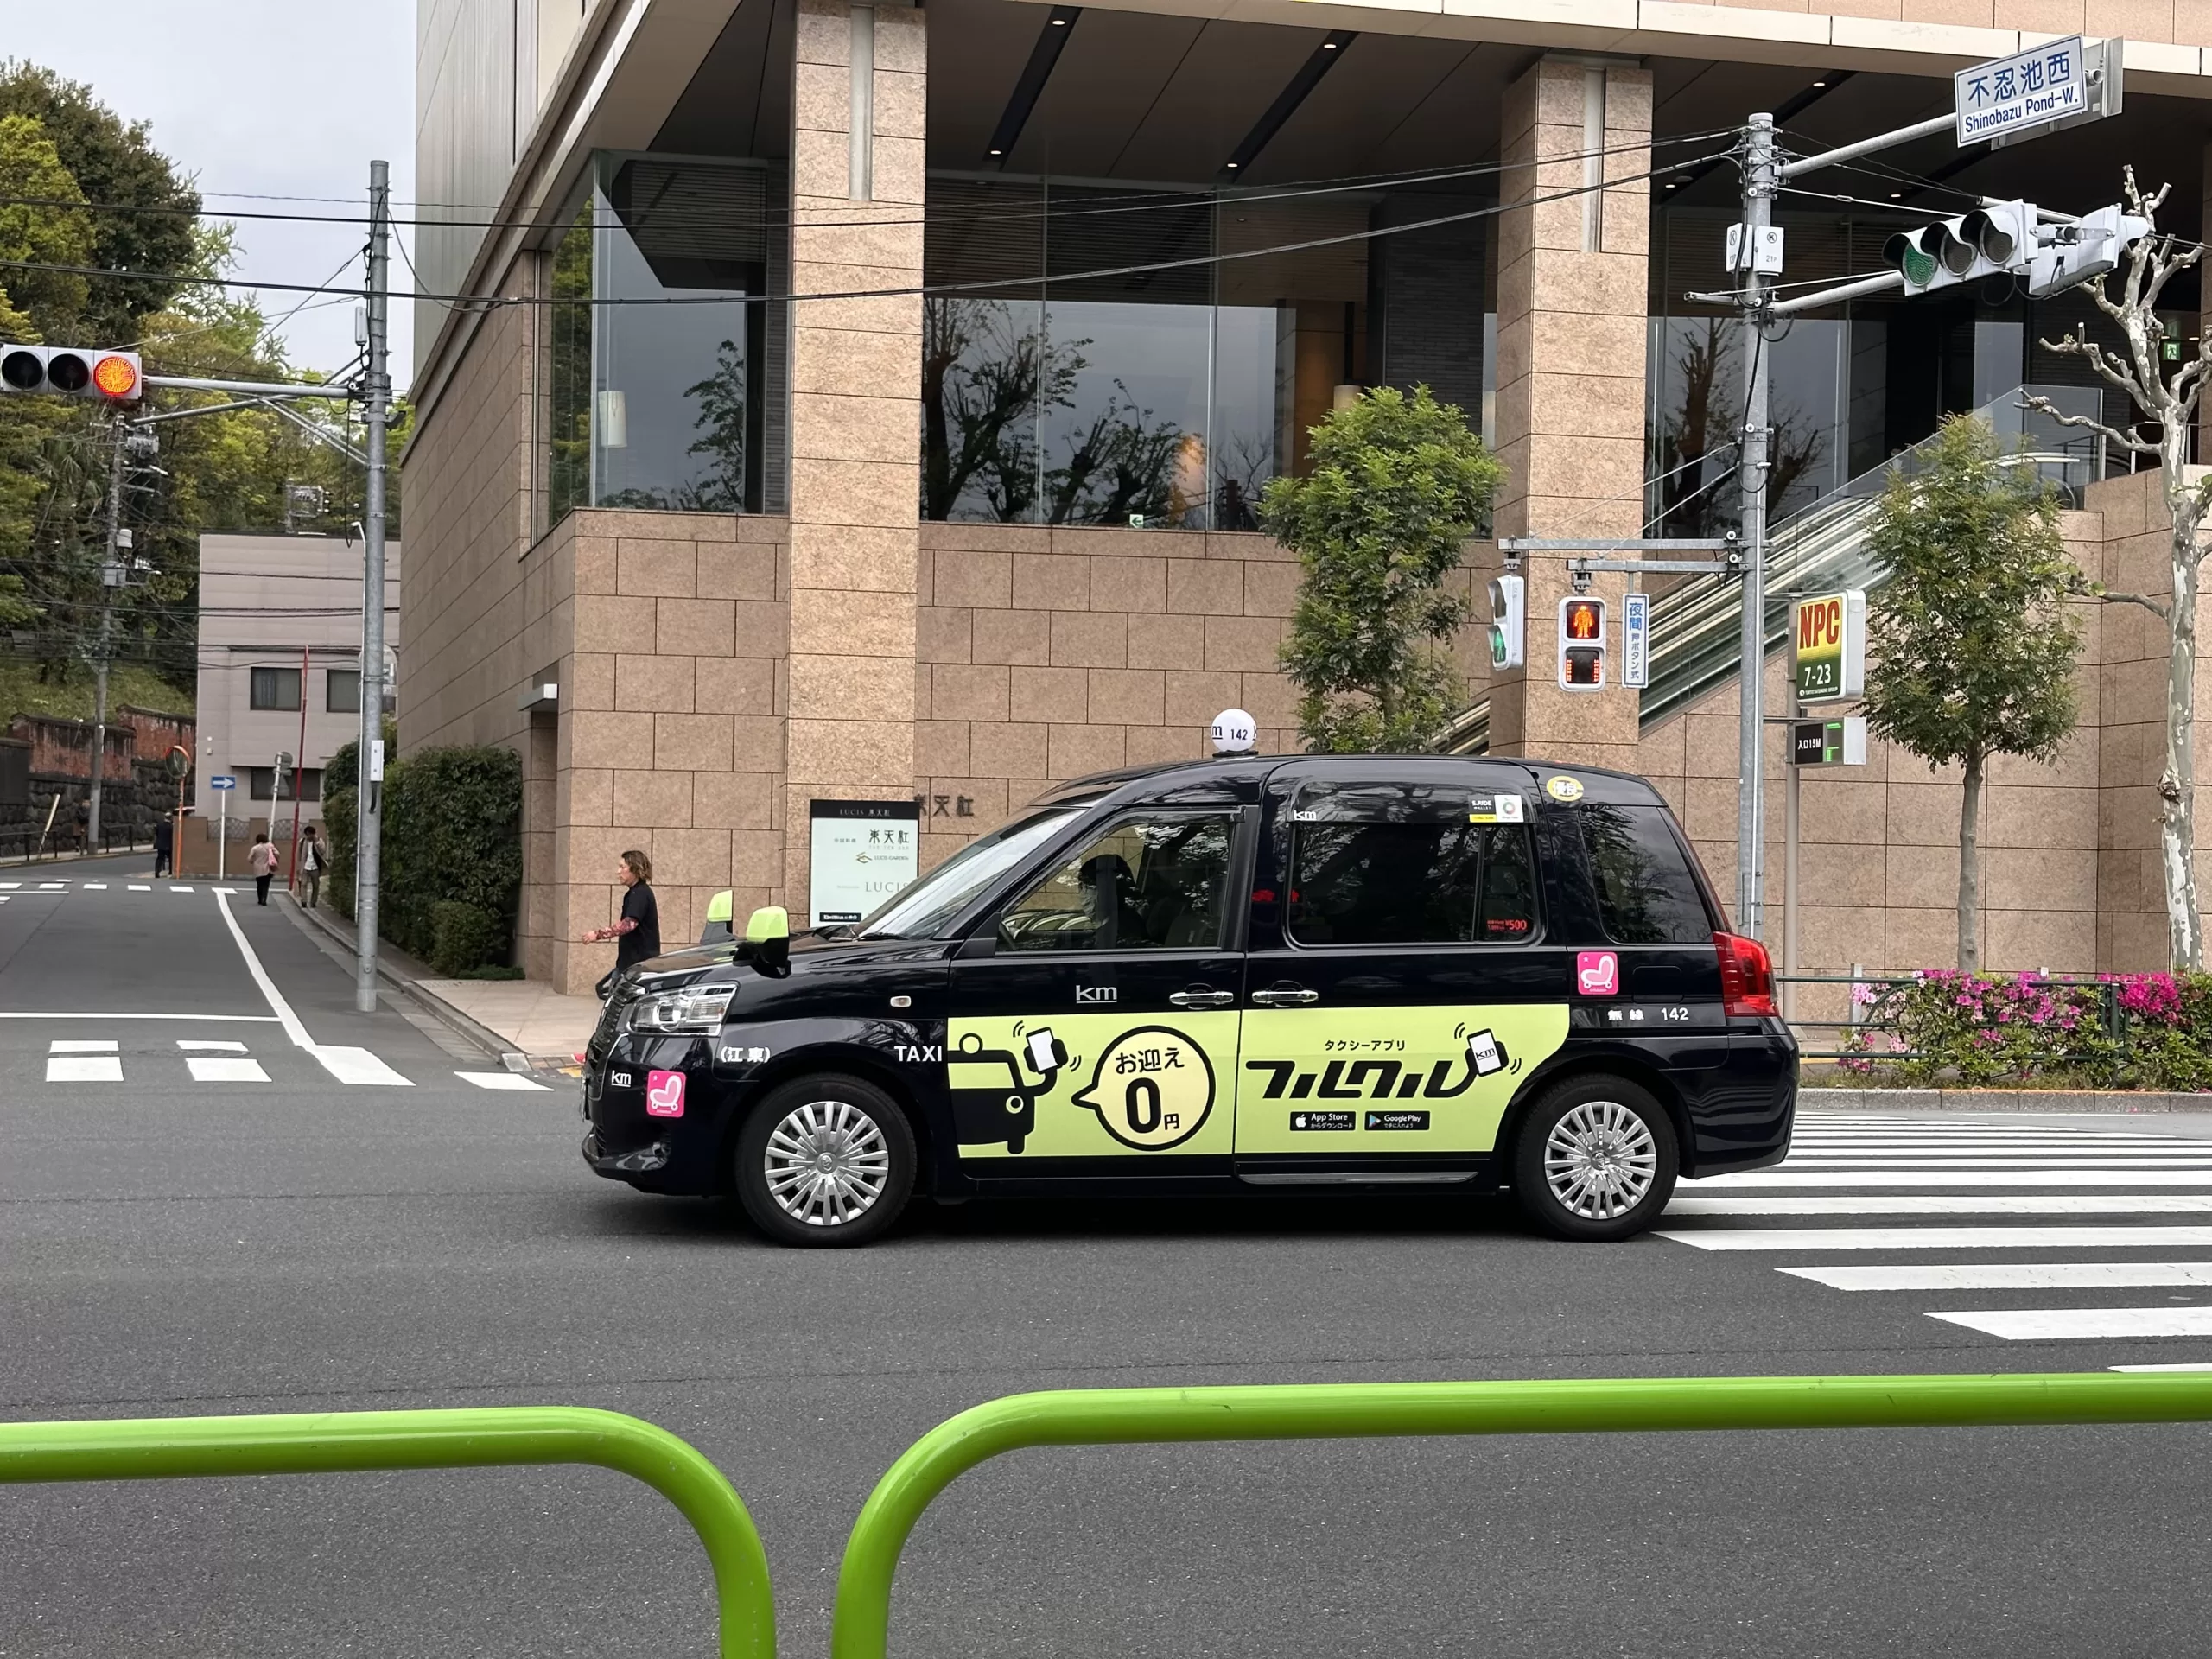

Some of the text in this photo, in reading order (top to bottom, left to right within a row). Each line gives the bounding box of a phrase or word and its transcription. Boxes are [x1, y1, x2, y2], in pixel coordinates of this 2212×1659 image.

[1967, 50, 2070, 108] 不忍池西
[1965, 86, 2078, 133] Shinobazu Pond-W.
[1629, 602, 1643, 631] 夜間
[1799, 601, 1840, 650] NPC
[1804, 664, 1831, 687] 7-23
[1230, 728, 1249, 741] 142
[1294, 810, 1318, 821] km
[868, 830, 910, 844] 東天紅
[1076, 985, 1118, 1004] km
[1661, 1007, 1689, 1020] 142
[894, 1046, 943, 1062] TAXI
[1325, 1039, 1406, 1052] タクシーアプリ
[1115, 1046, 1185, 1075] お迎え
[611, 1070, 632, 1088] km
[1311, 1113, 1348, 1122] App Store
[1383, 1115, 1408, 1123] Google
